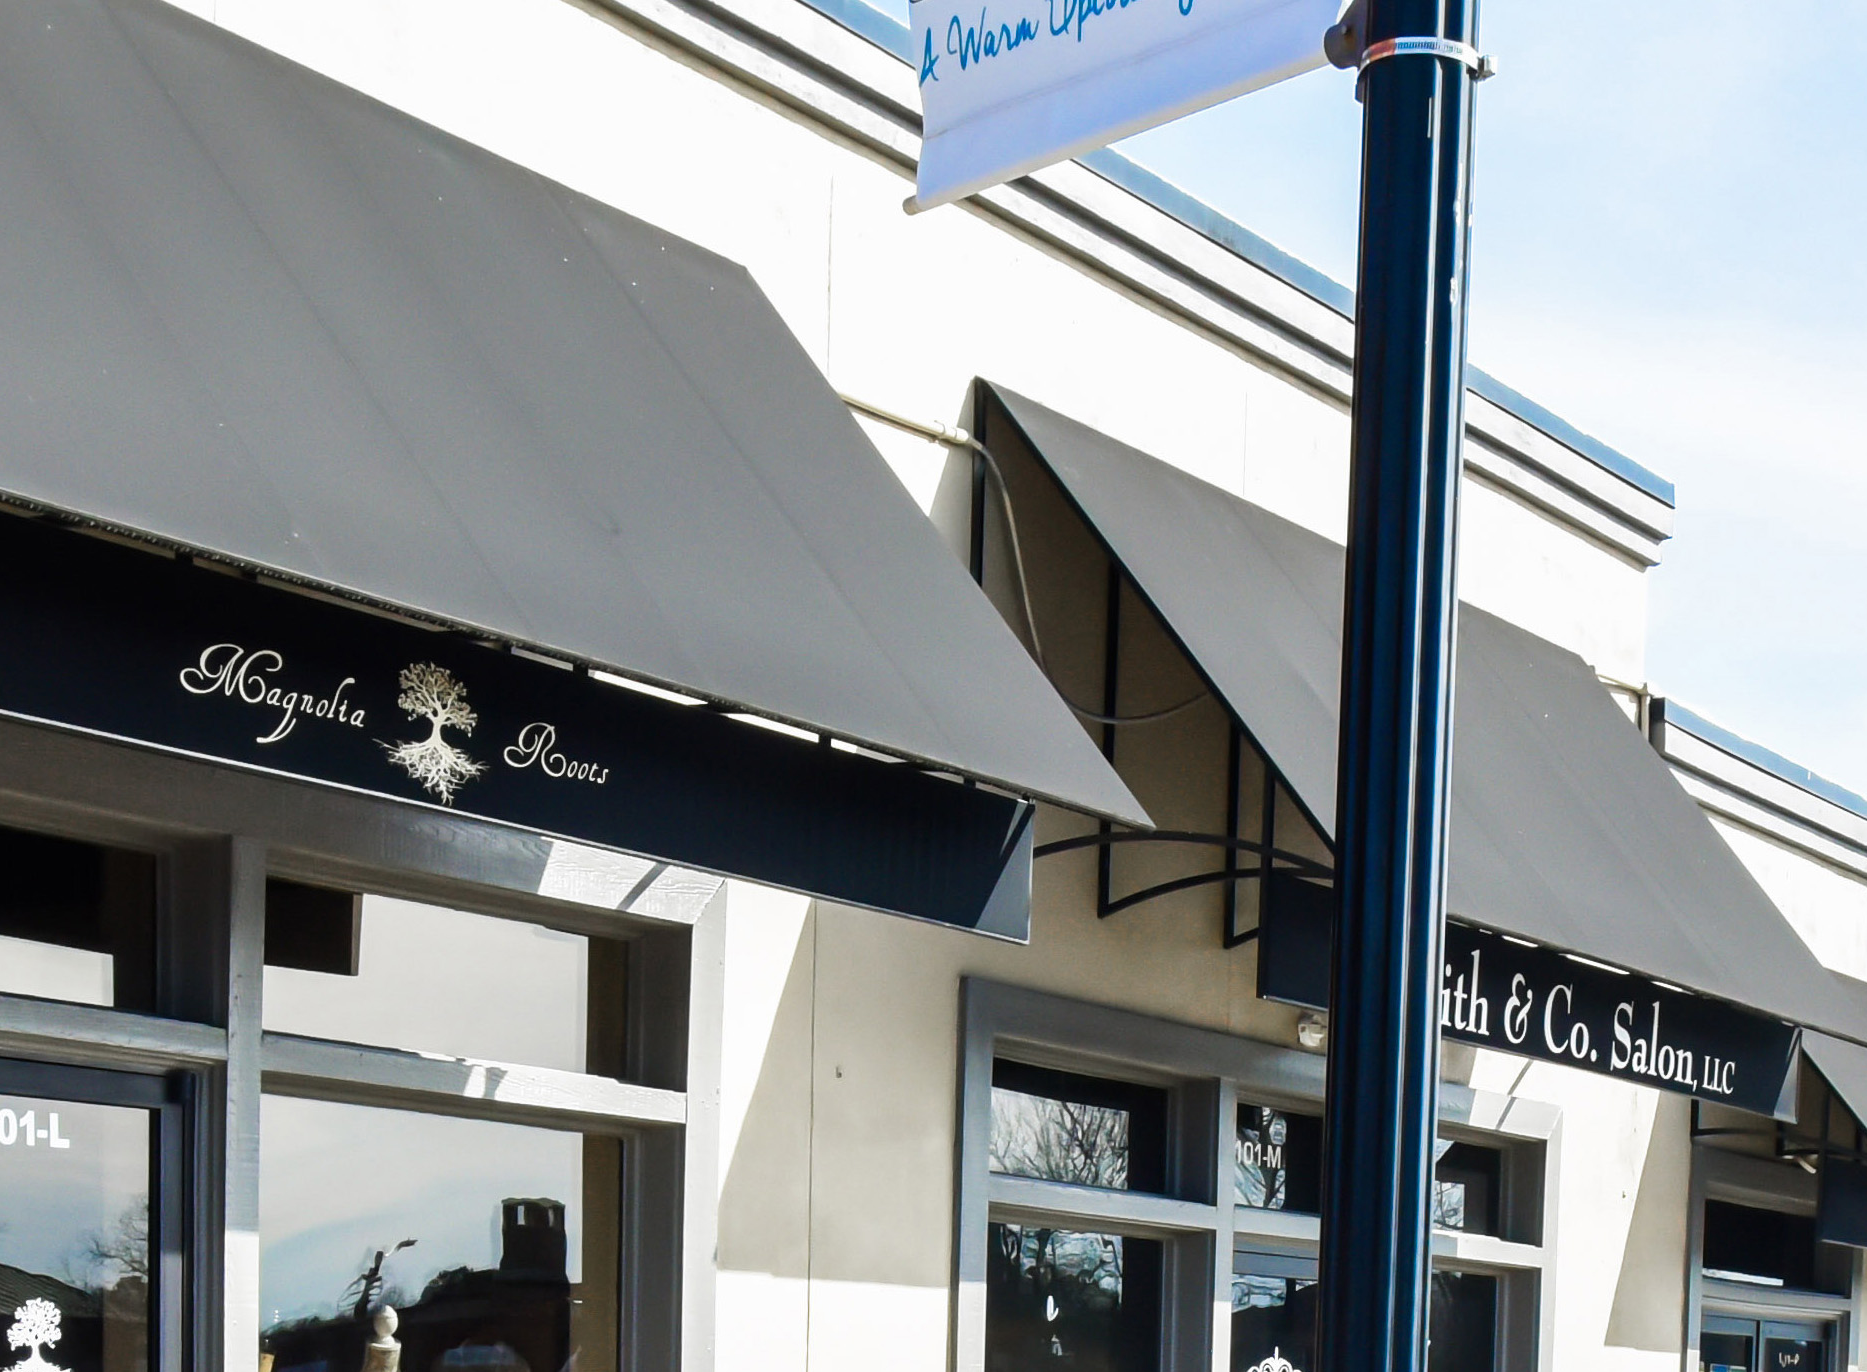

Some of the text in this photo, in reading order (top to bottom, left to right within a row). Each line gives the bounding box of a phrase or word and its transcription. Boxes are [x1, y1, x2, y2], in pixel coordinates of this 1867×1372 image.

[919, 27, 939, 86] A
[947, 7, 1039, 70] Warm
[180, 643, 609, 784] Magnolia Roots
[1441, 949, 1735, 1094] ith & Co. Salon, LLC
[1235, 1140, 1282, 1169] 101-M
